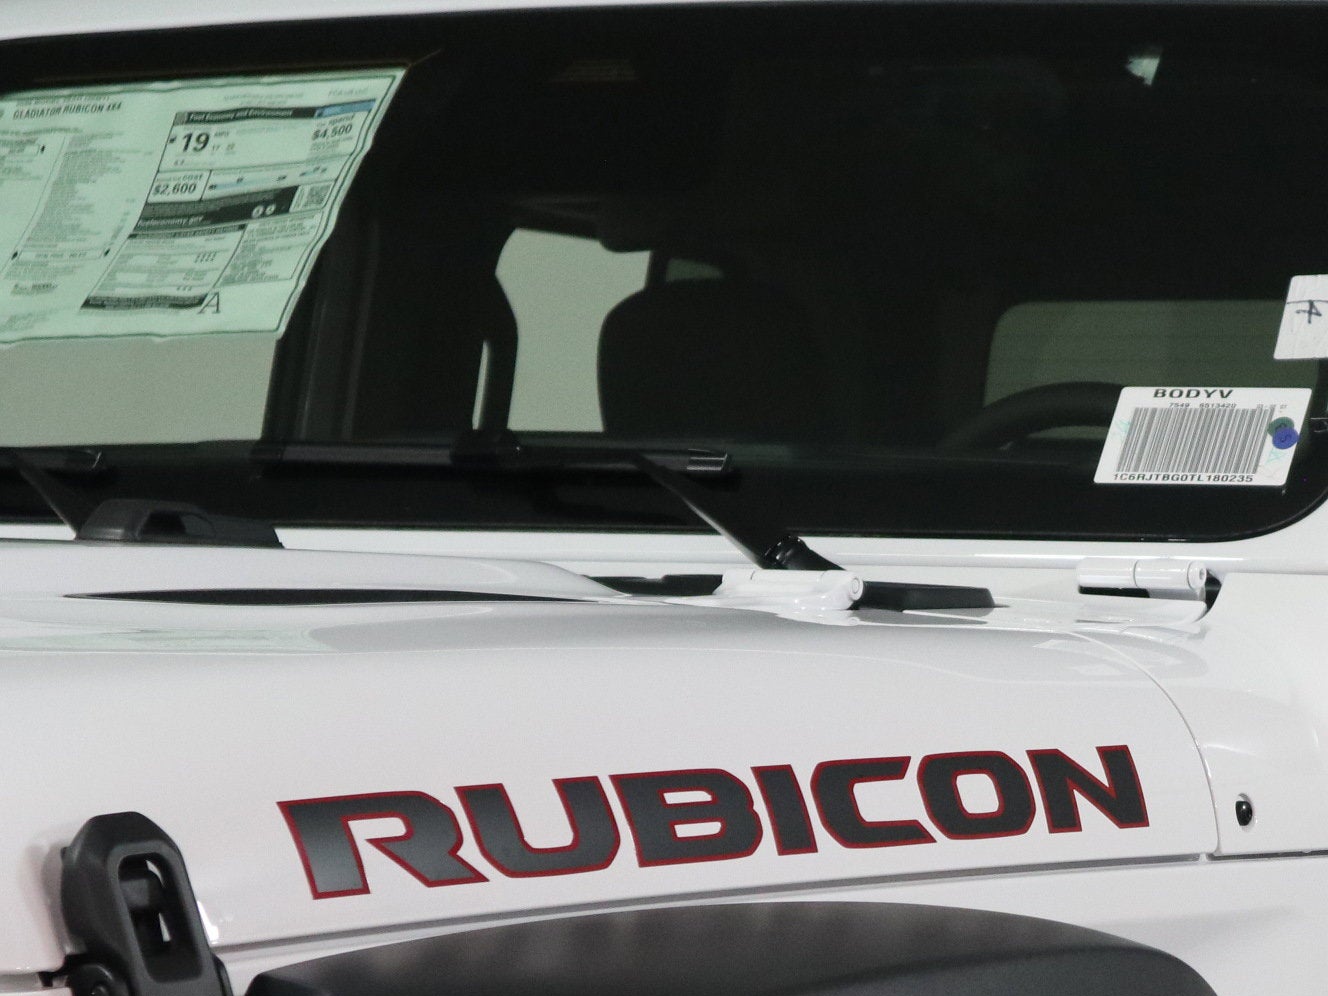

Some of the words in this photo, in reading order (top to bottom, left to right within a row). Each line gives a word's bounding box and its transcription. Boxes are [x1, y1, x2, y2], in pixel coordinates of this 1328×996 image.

[13, 106, 62, 119] GLADIATOR
[63, 102, 105, 114] RUBICON
[312, 123, 353, 140] $4,500
[182, 132, 210, 153] 19
[152, 182, 197, 197] $2,600
[1153, 388, 1234, 400] BODYV
[276, 744, 1151, 901] RUBICON
